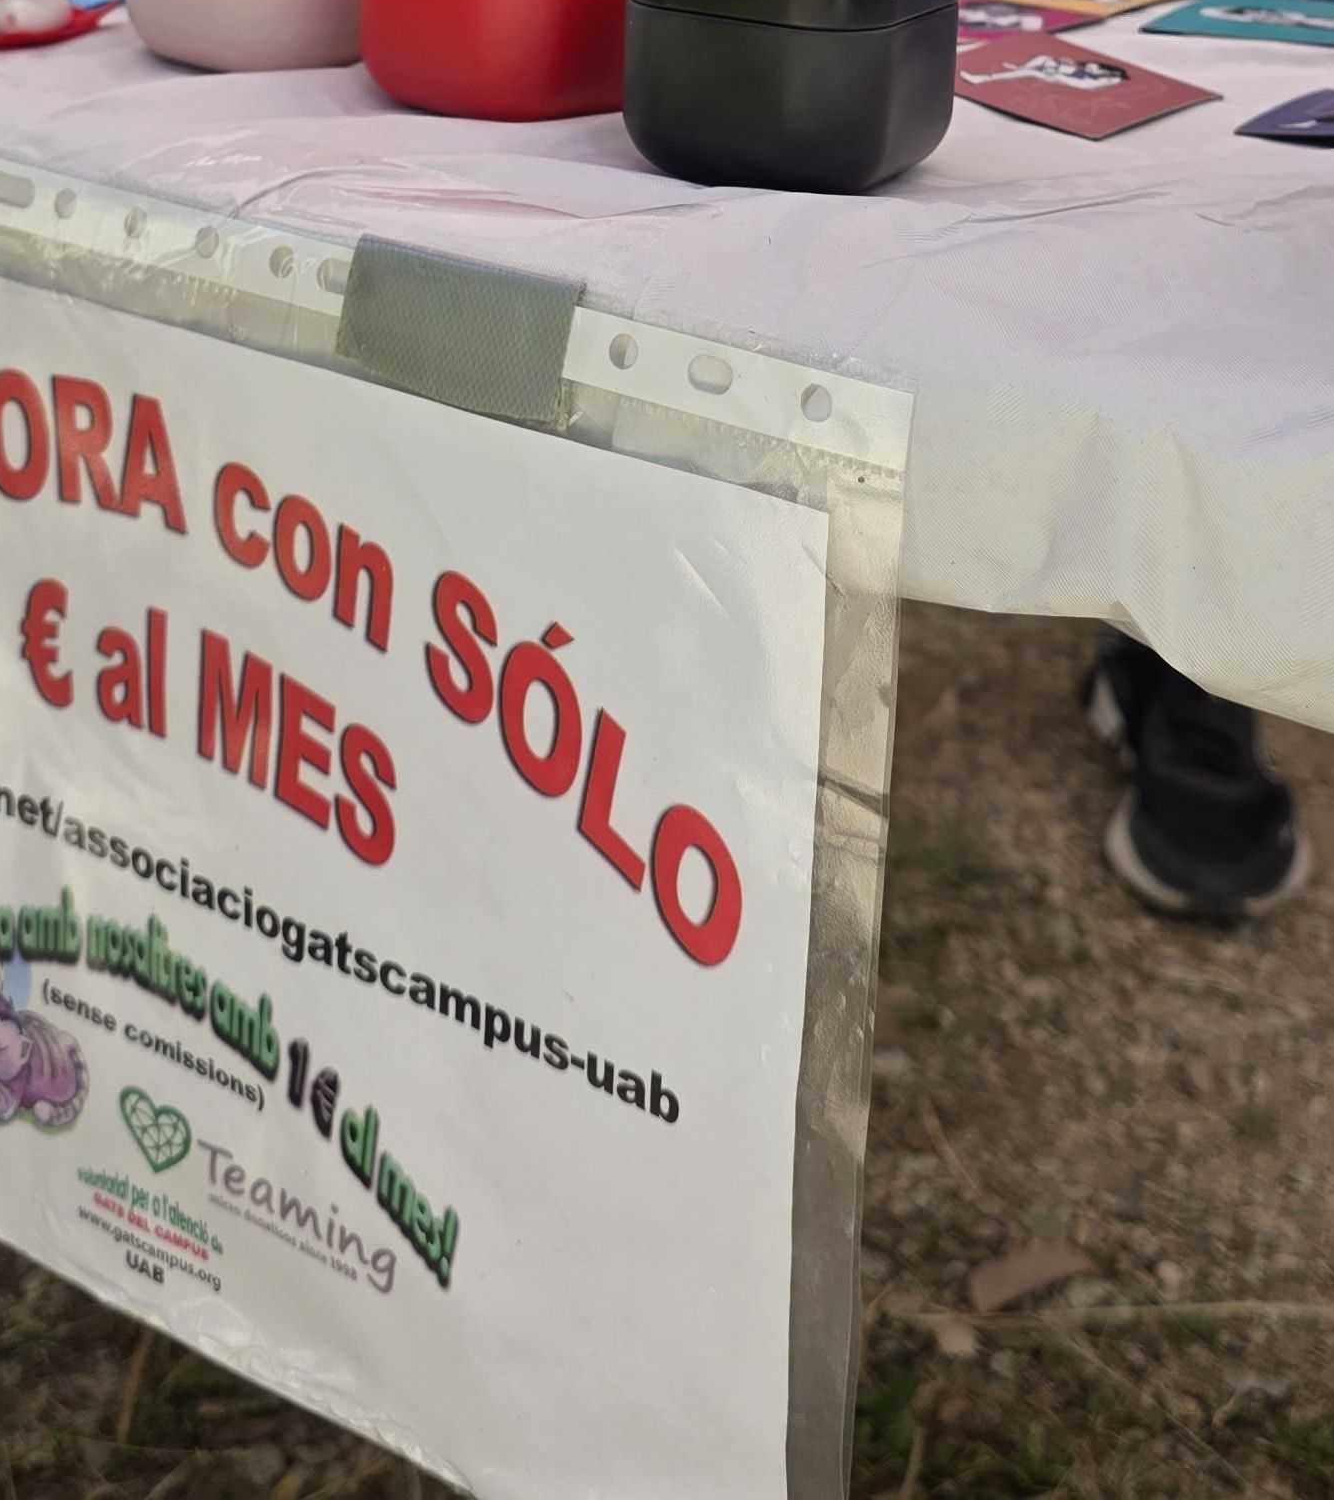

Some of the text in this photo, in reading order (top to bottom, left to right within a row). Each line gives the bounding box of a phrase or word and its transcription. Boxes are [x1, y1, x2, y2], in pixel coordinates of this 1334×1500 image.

[20, 578, 74, 708] €
[96, 606, 169, 739] al
[197, 628, 397, 868] MES
[214, 462, 395, 653] con
[425, 570, 743, 968] SÓLO
[18, 884, 82, 966] amb
[86, 912, 208, 1022] nosaltres
[210, 979, 281, 1082] amb
[376, 1149, 459, 1289] mes!
[42, 978, 265, 1113] (sense comissions)
[78, 1204, 223, 1292] www.gatscampus.org
[93, 1191, 209, 1261] GATS DEL CAMPUS
[125, 1250, 165, 1284] UAB
[198, 1138, 397, 1294] Teaming
[299, 1237, 328, 1265] since
[329, 1254, 358, 1281] 1998
